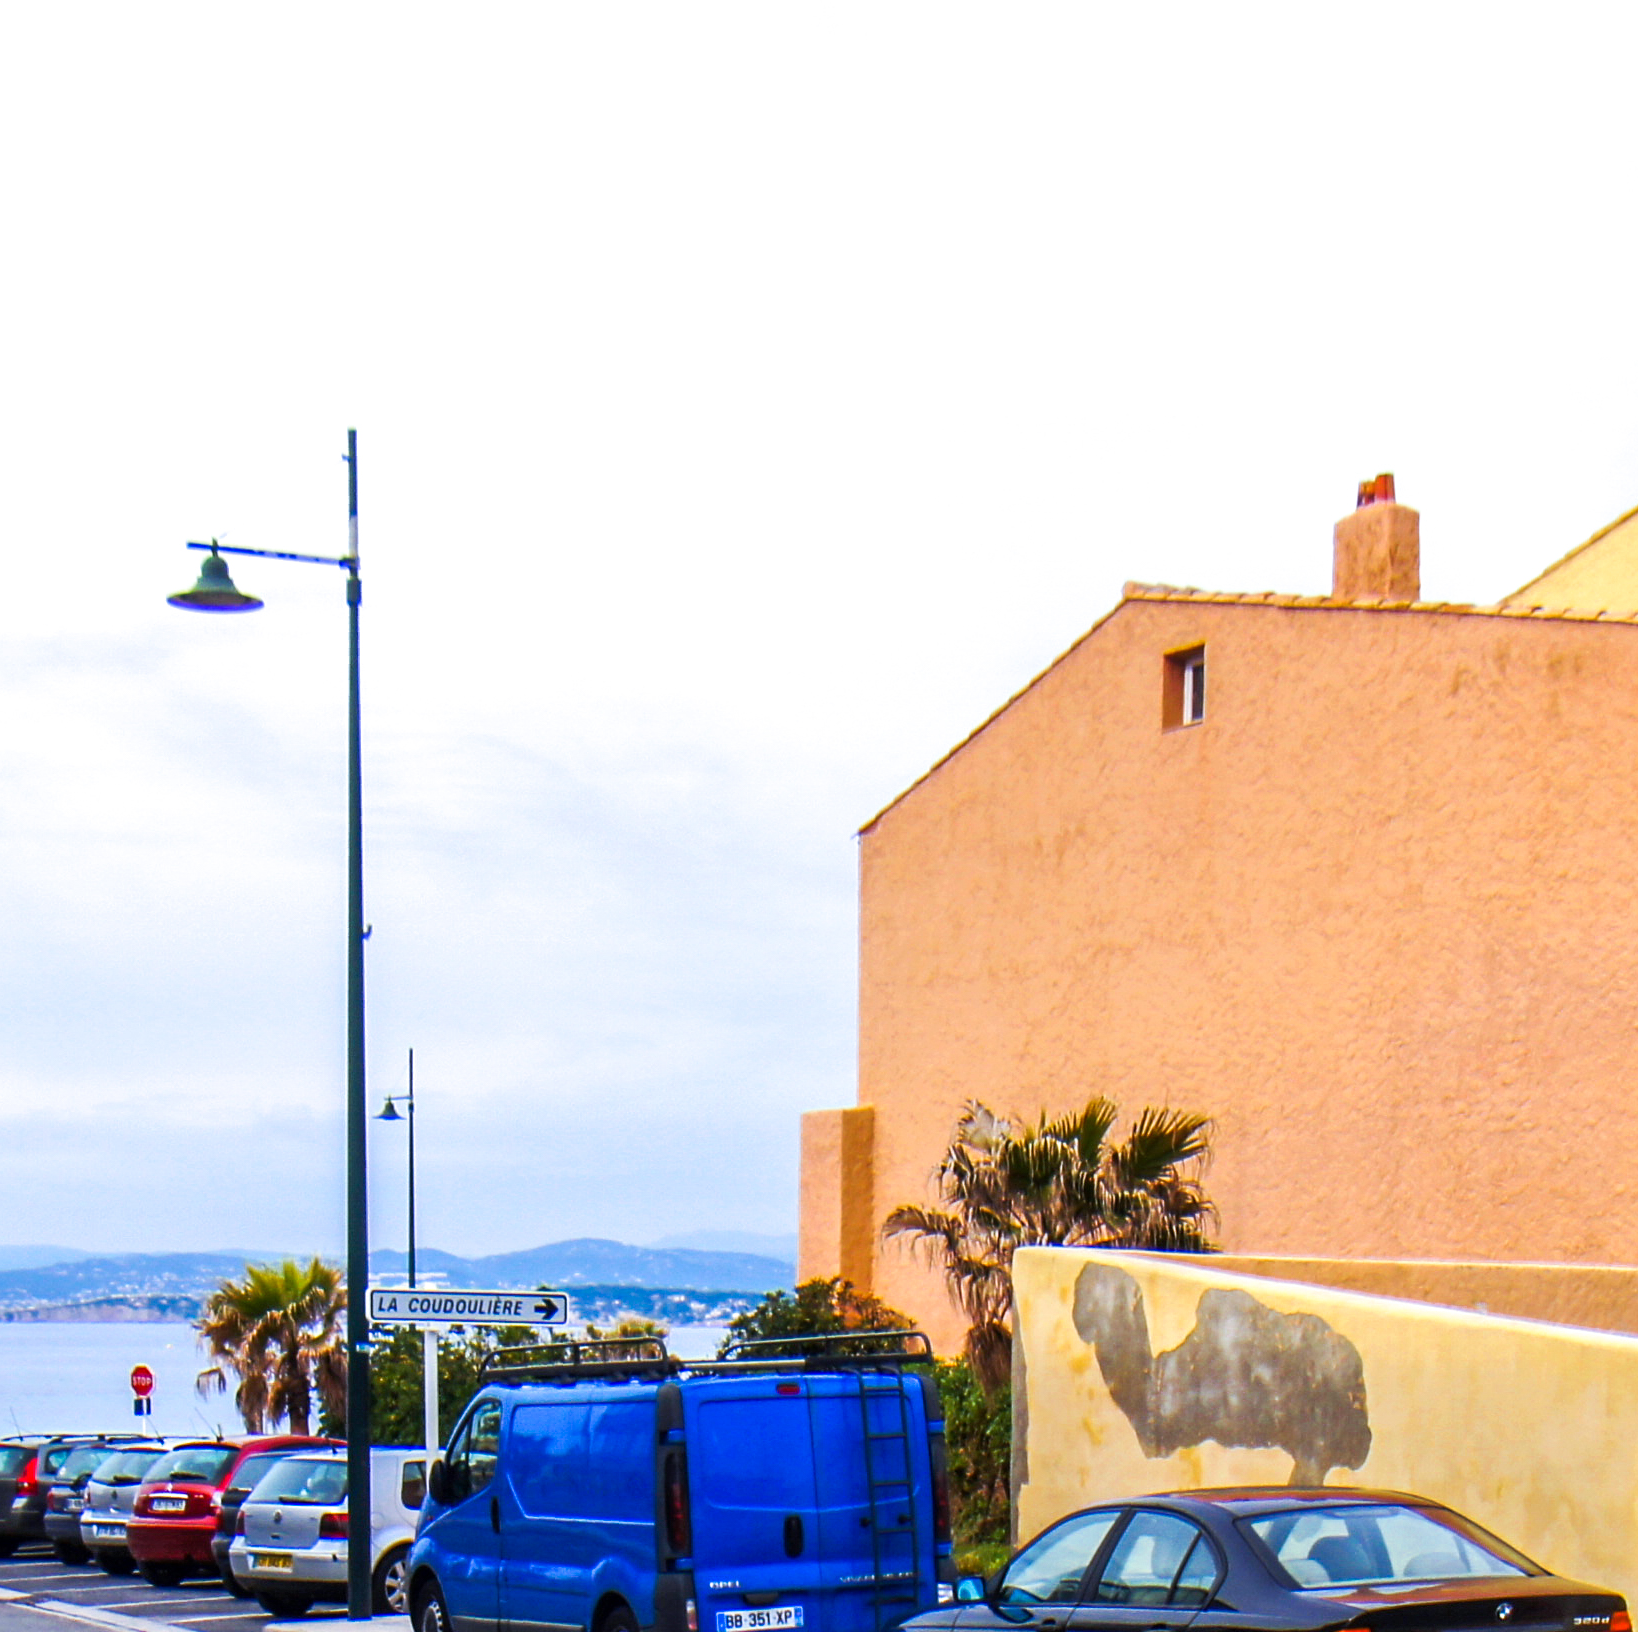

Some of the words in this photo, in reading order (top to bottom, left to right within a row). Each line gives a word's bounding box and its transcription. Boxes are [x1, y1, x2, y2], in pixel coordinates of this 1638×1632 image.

[377, 1296, 398, 1312] LA
[407, 1296, 524, 1316] COUDOULIÈRE
[133, 1376, 152, 1386] STOP
